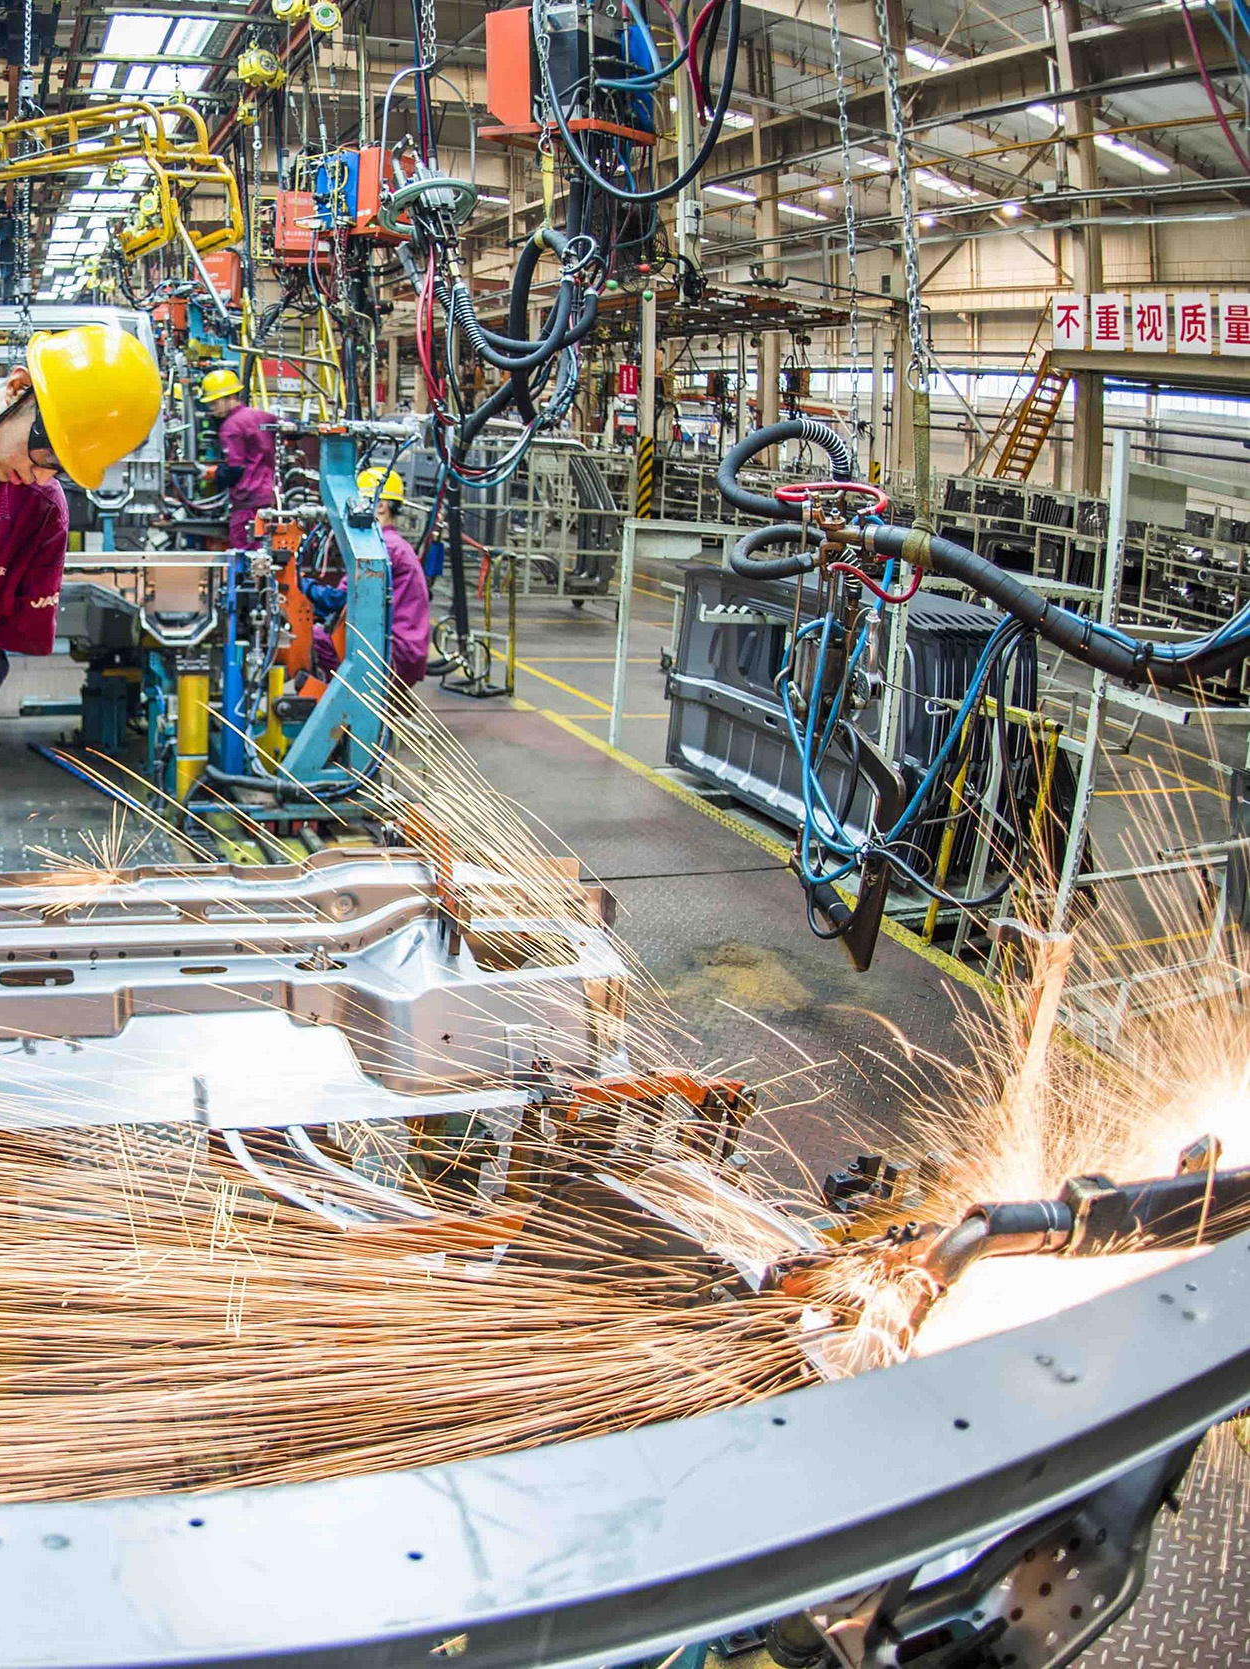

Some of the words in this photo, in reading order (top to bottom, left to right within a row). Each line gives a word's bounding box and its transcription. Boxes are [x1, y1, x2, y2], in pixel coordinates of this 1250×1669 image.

[1057, 304, 1250, 344] 不重视质量
